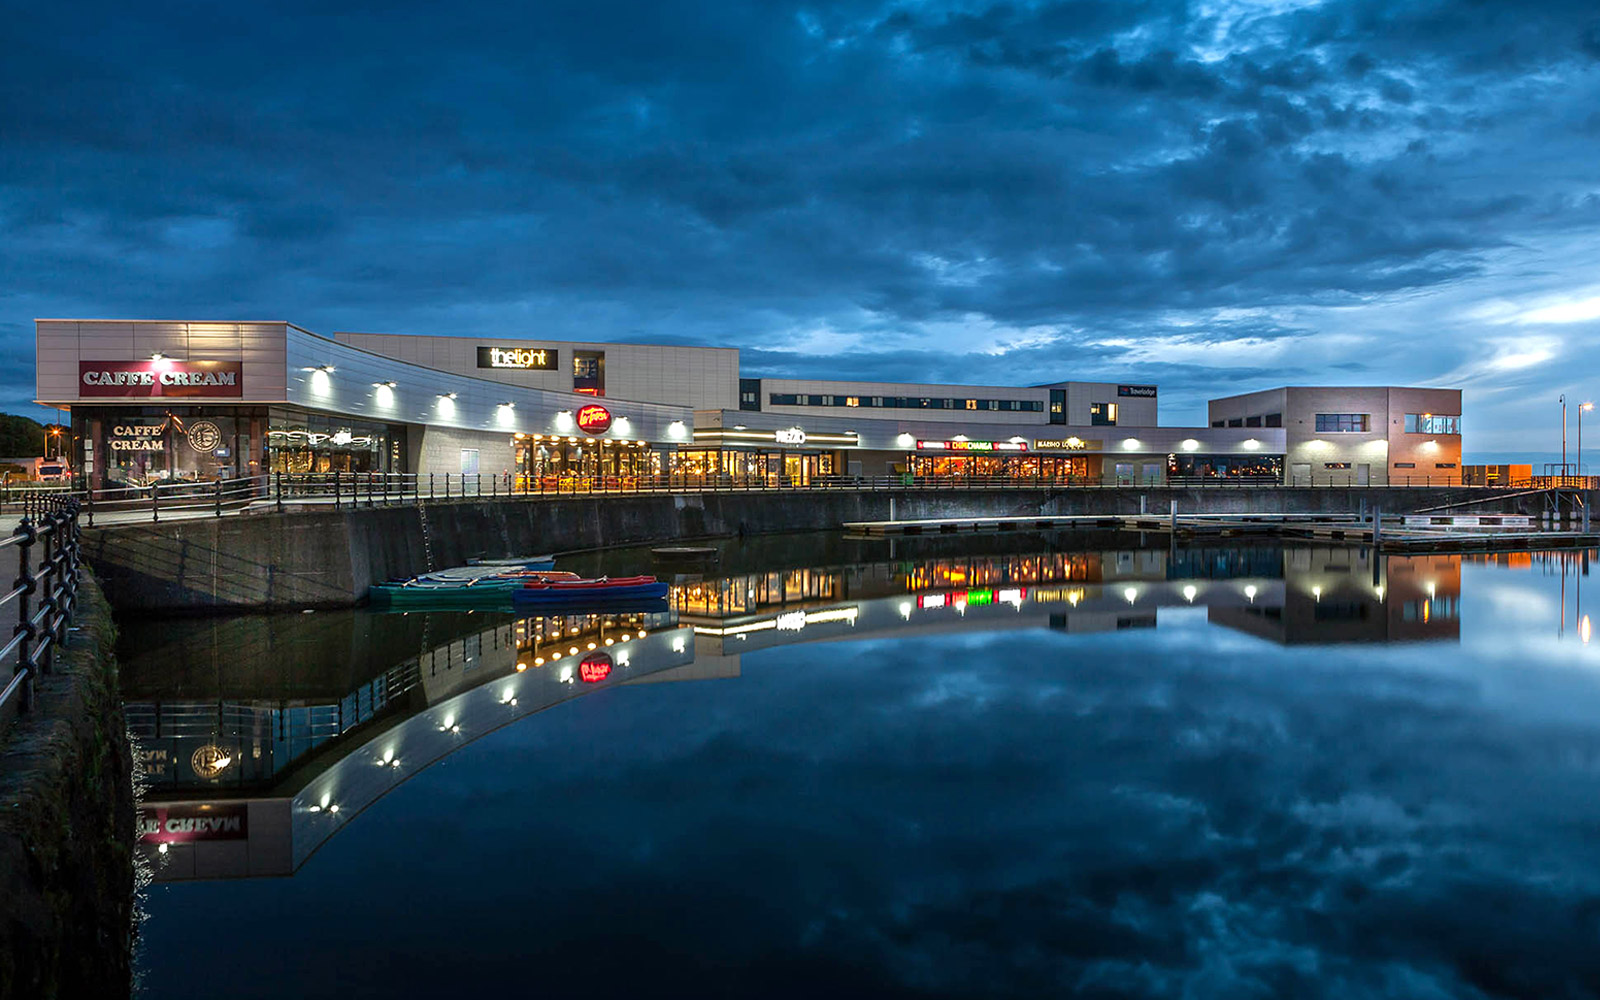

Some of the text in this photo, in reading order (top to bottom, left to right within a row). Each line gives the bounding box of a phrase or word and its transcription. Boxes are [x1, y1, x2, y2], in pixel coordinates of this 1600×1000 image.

[490, 348, 546, 368] thelight
[83, 371, 236, 386] CAFFE CREAM
[113, 425, 162, 436] CAFFE
[110, 440, 164, 450] CREAM
